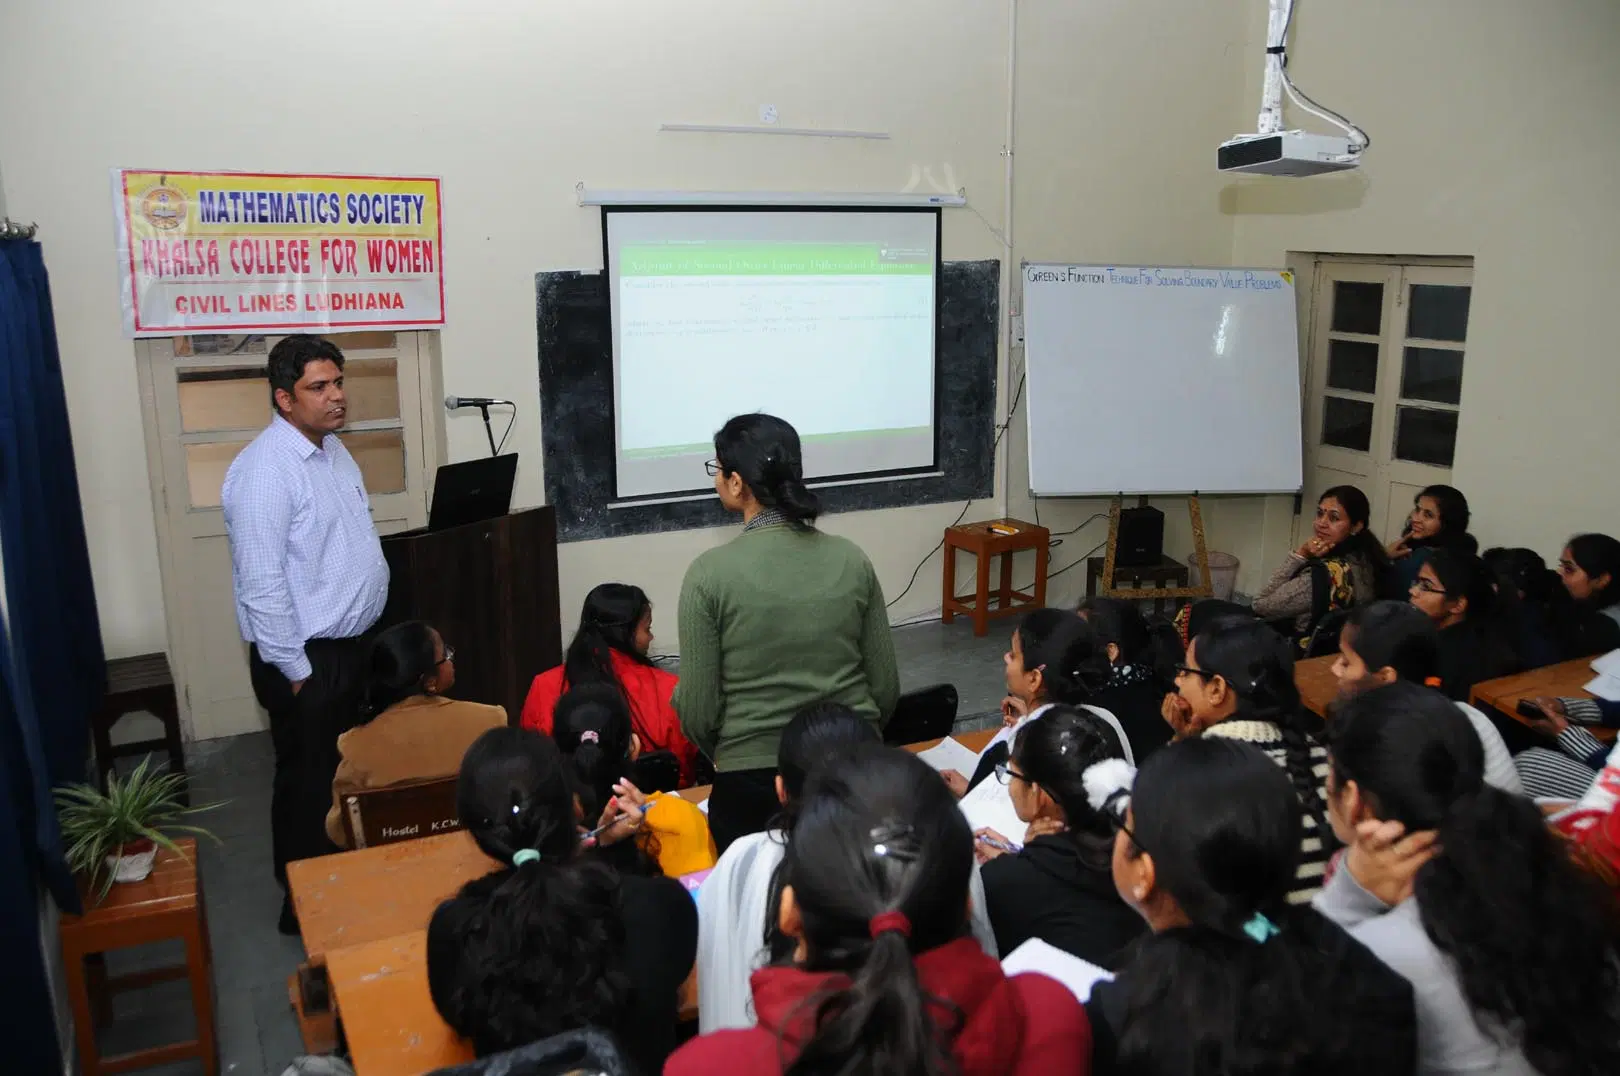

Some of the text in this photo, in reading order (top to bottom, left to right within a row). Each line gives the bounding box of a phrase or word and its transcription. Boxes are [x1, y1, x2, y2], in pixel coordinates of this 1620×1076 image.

[200, 191, 340, 223] MATHEMATICS
[346, 193, 424, 225] SOCIETY
[141, 238, 434, 278] KHALSA COLLEGE FOR WOMEN
[175, 292, 405, 314] CIVIL LINES LUDHIANA
[382, 824, 419, 837] Hostel
